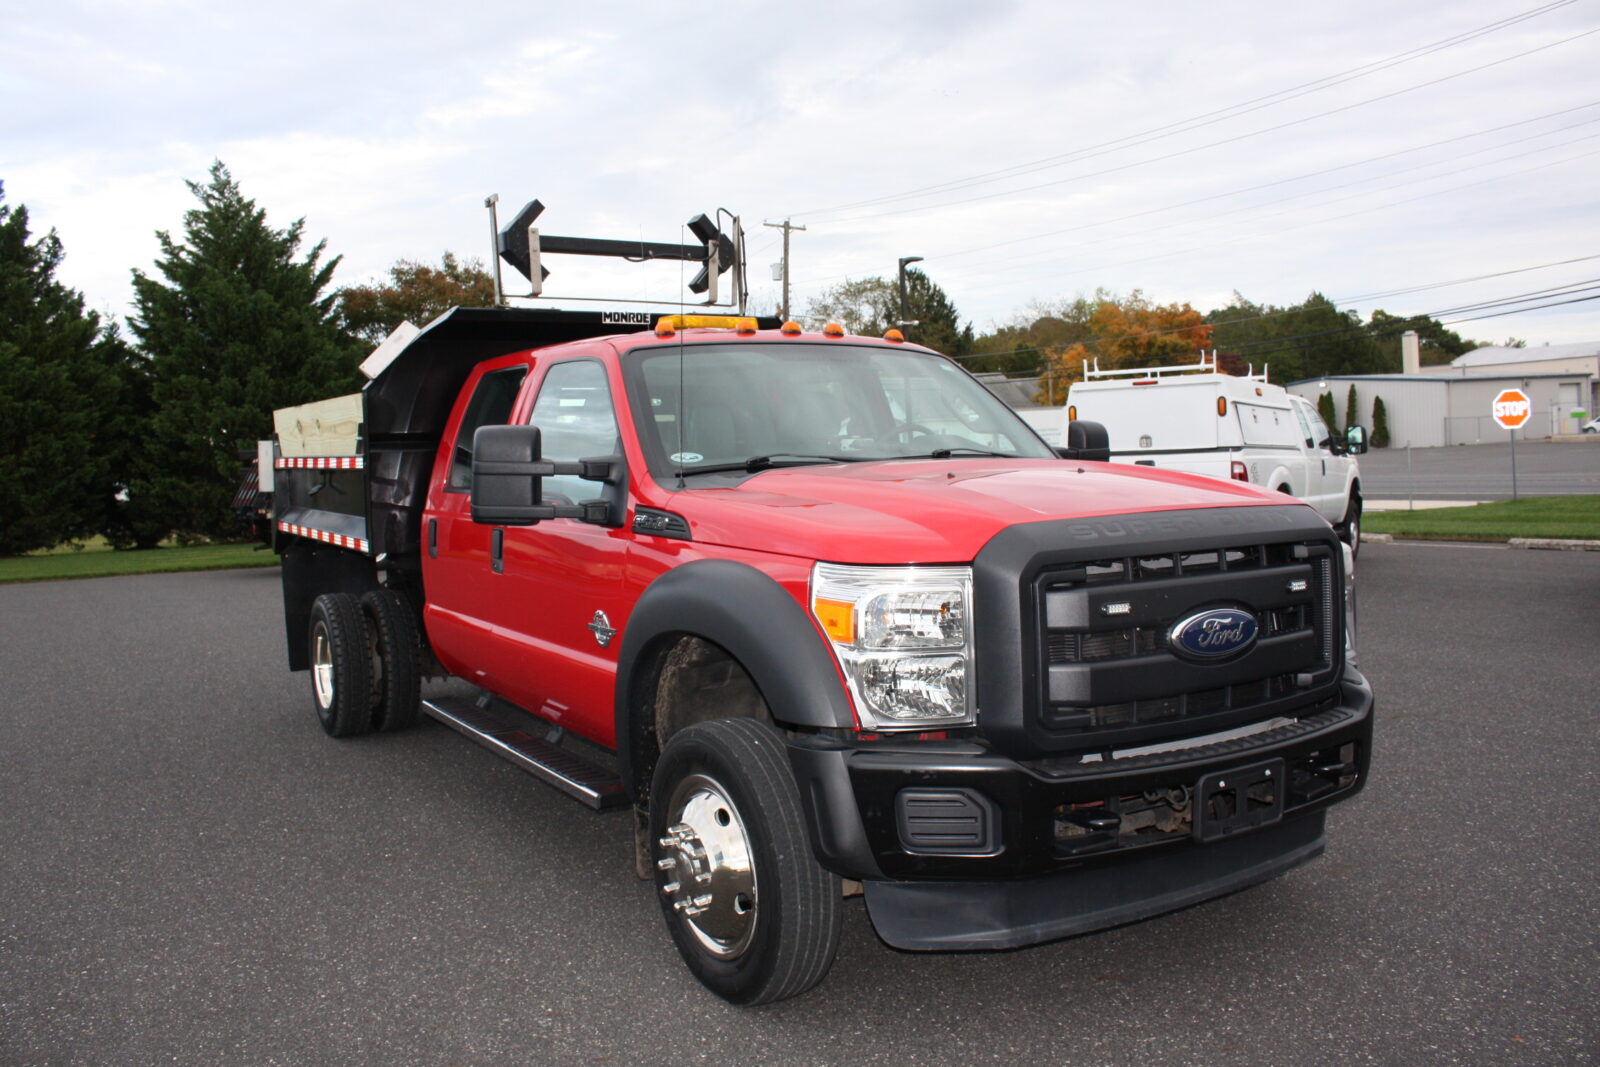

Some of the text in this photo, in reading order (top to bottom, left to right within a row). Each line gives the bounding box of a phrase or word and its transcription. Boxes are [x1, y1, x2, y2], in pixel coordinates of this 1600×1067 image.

[602, 311, 650, 323] MONROE
[1495, 401, 1528, 417] STOP
[1067, 513, 1201, 539] SUPER
[1199, 617, 1244, 647] Ford
